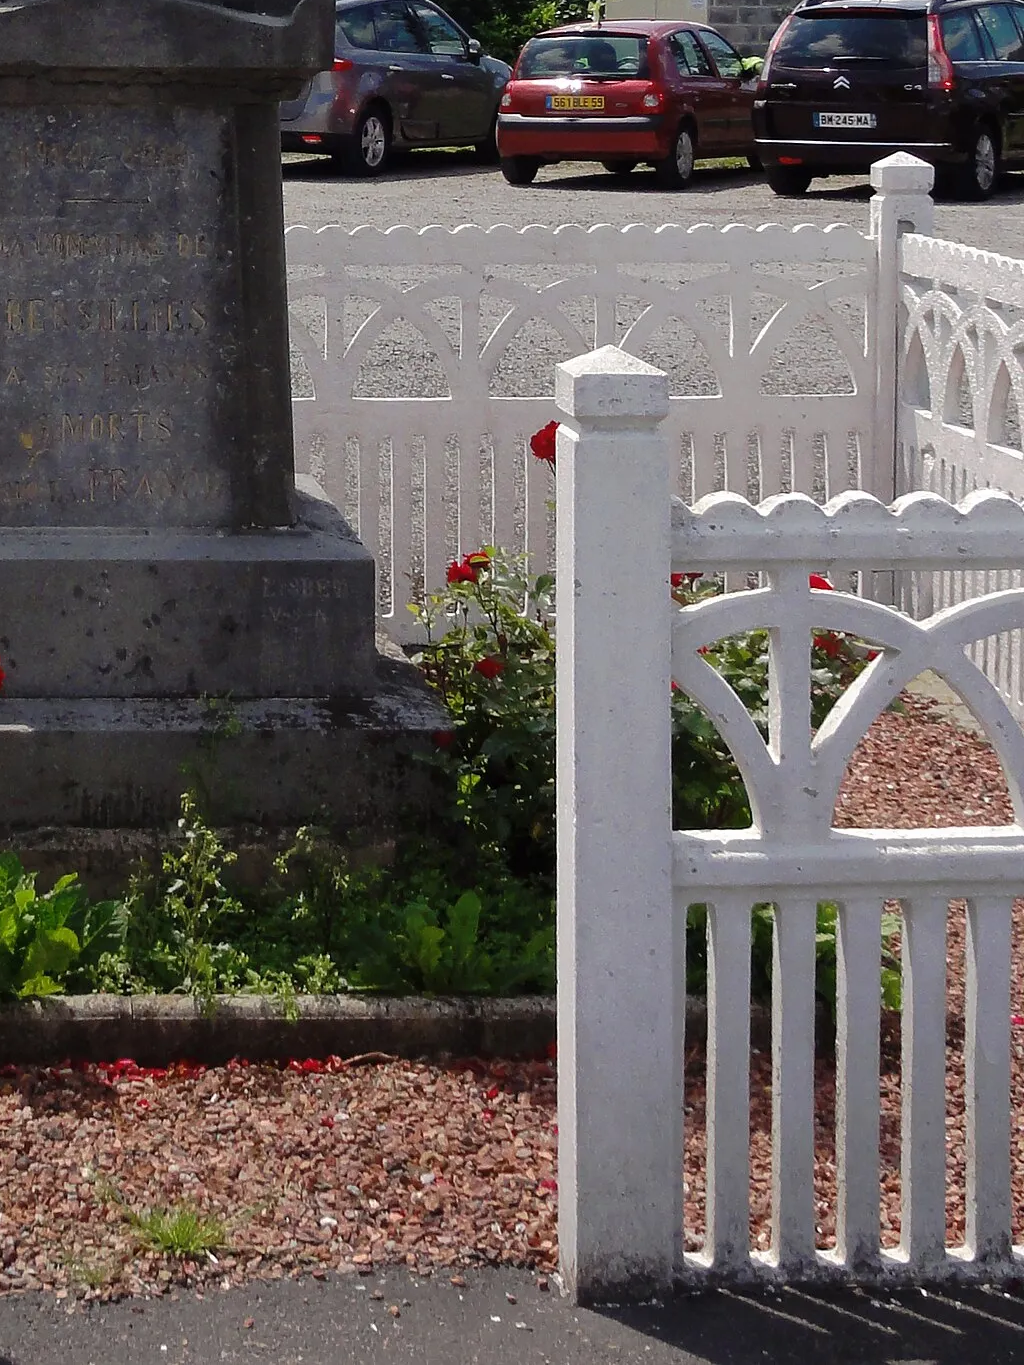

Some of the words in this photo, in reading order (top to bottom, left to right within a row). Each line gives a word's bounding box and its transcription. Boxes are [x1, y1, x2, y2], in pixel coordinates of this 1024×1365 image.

[553, 97, 572, 108] 561
[591, 97, 604, 108] 59
[61, 410, 173, 442] MORTS
